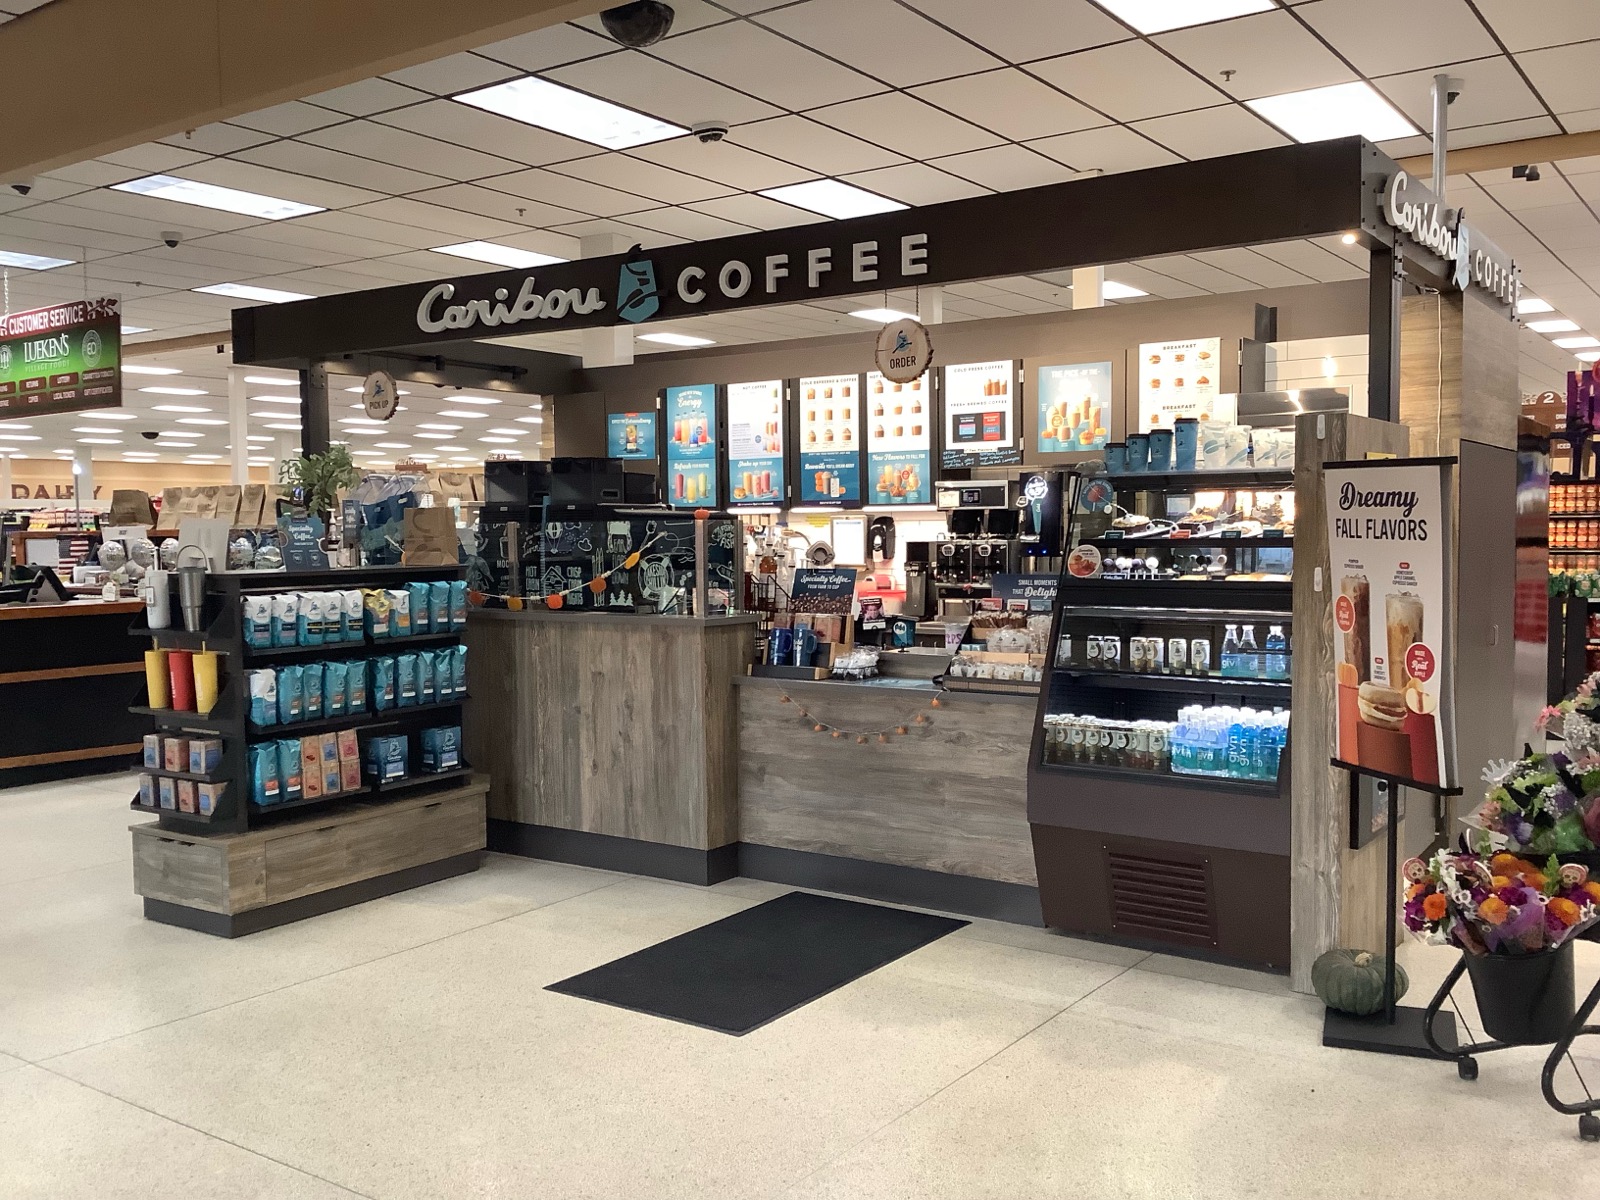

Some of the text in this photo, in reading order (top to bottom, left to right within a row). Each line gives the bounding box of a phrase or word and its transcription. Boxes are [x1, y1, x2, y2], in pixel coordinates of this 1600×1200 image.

[417, 233, 927, 333] Caribou COFFEE
[9, 304, 84, 335] CUSTOMER SERVICE
[23, 333, 70, 363] LUEKEN'S
[890, 355, 917, 370] ORDER
[370, 399, 389, 410] PICK UP
[677, 397, 703, 409] Energy
[1543, 392, 1555, 404] 2
[1339, 482, 1419, 518] Dreamy
[287, 524, 314, 534] Specialty
[293, 532, 314, 541] Coffee
[1336, 518, 1428, 541] FALL FLAVORS
[800, 574, 852, 584] Specialty Coffee
[1411, 660, 1429, 671] Real
[1228, 735, 1241, 763] givn
[1239, 738, 1250, 767] givn
